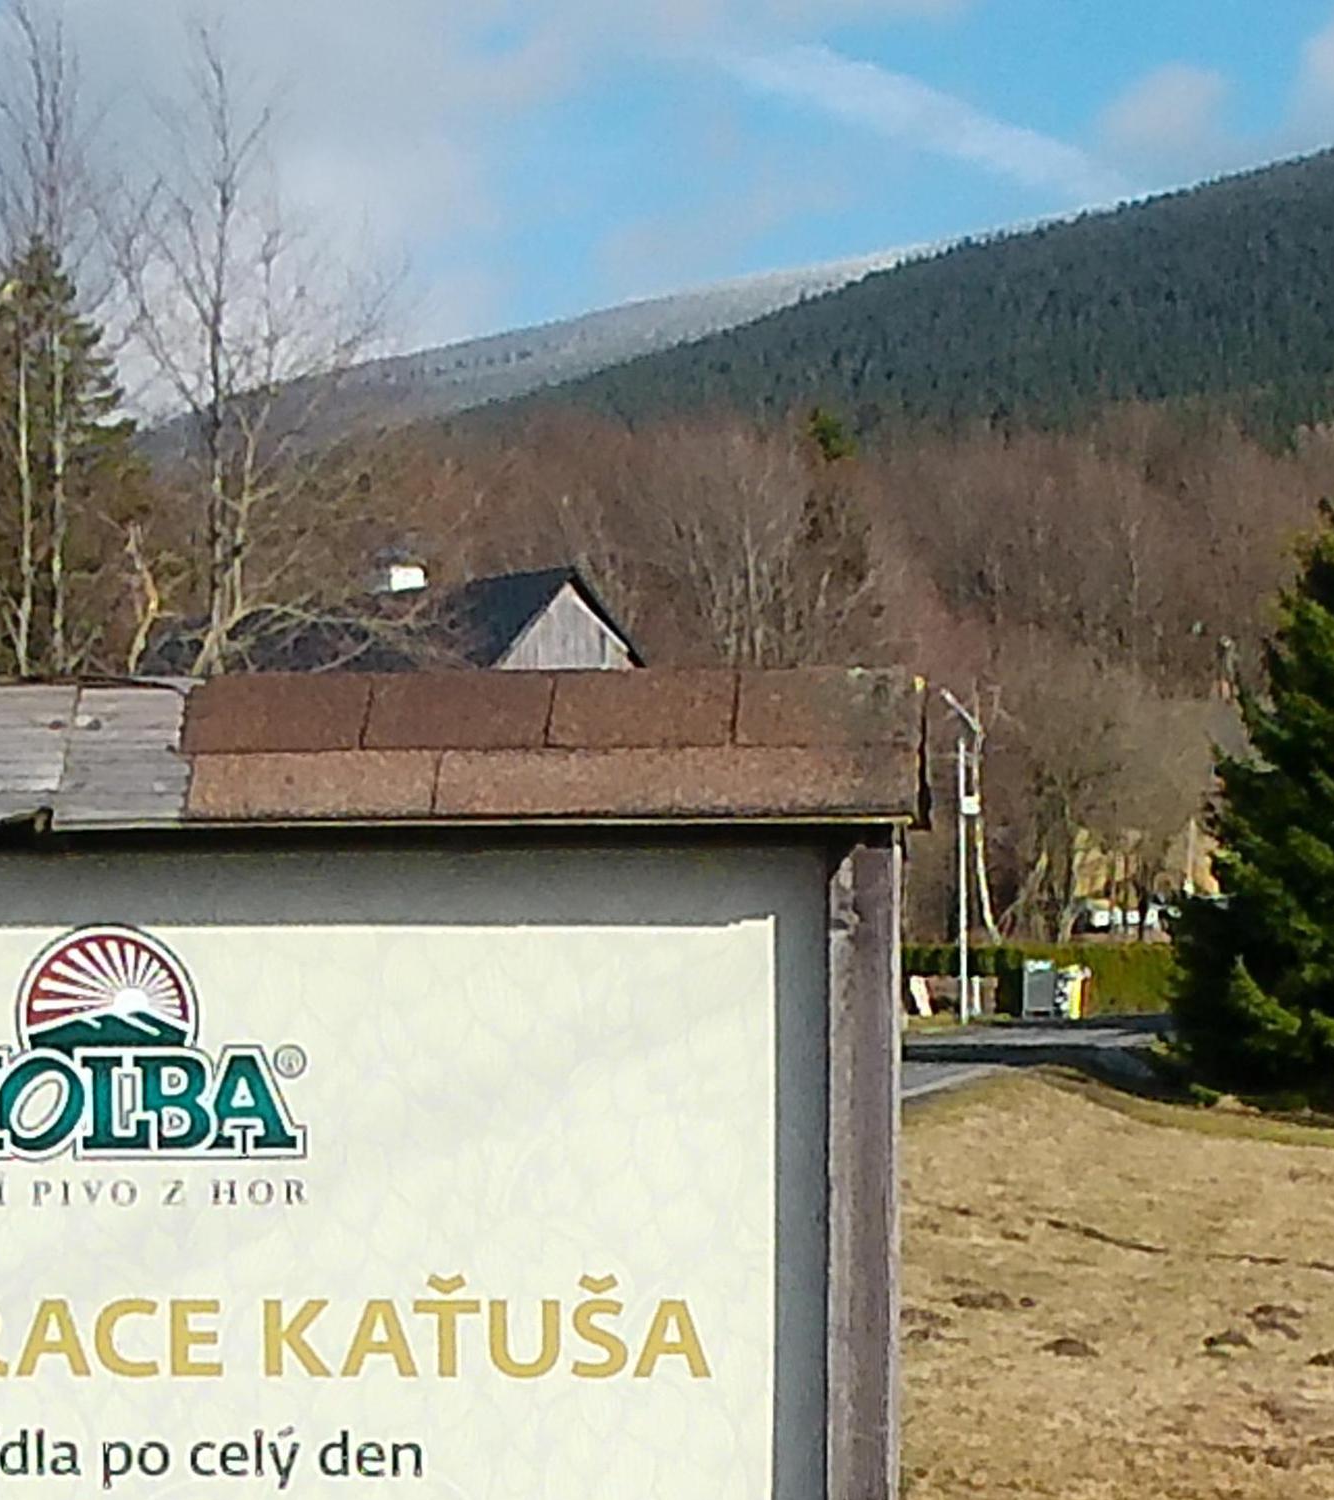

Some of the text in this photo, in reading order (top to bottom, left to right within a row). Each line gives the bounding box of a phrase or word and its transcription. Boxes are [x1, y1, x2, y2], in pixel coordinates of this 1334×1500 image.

[33, 1179, 138, 1206] PIVO
[163, 1179, 186, 1205] Z
[211, 1179, 308, 1205] HOR
[264, 1276, 711, 1378] KAŤUŠA
[102, 1441, 171, 1489] po
[189, 1427, 300, 1490] celý
[318, 1430, 424, 1478] den
